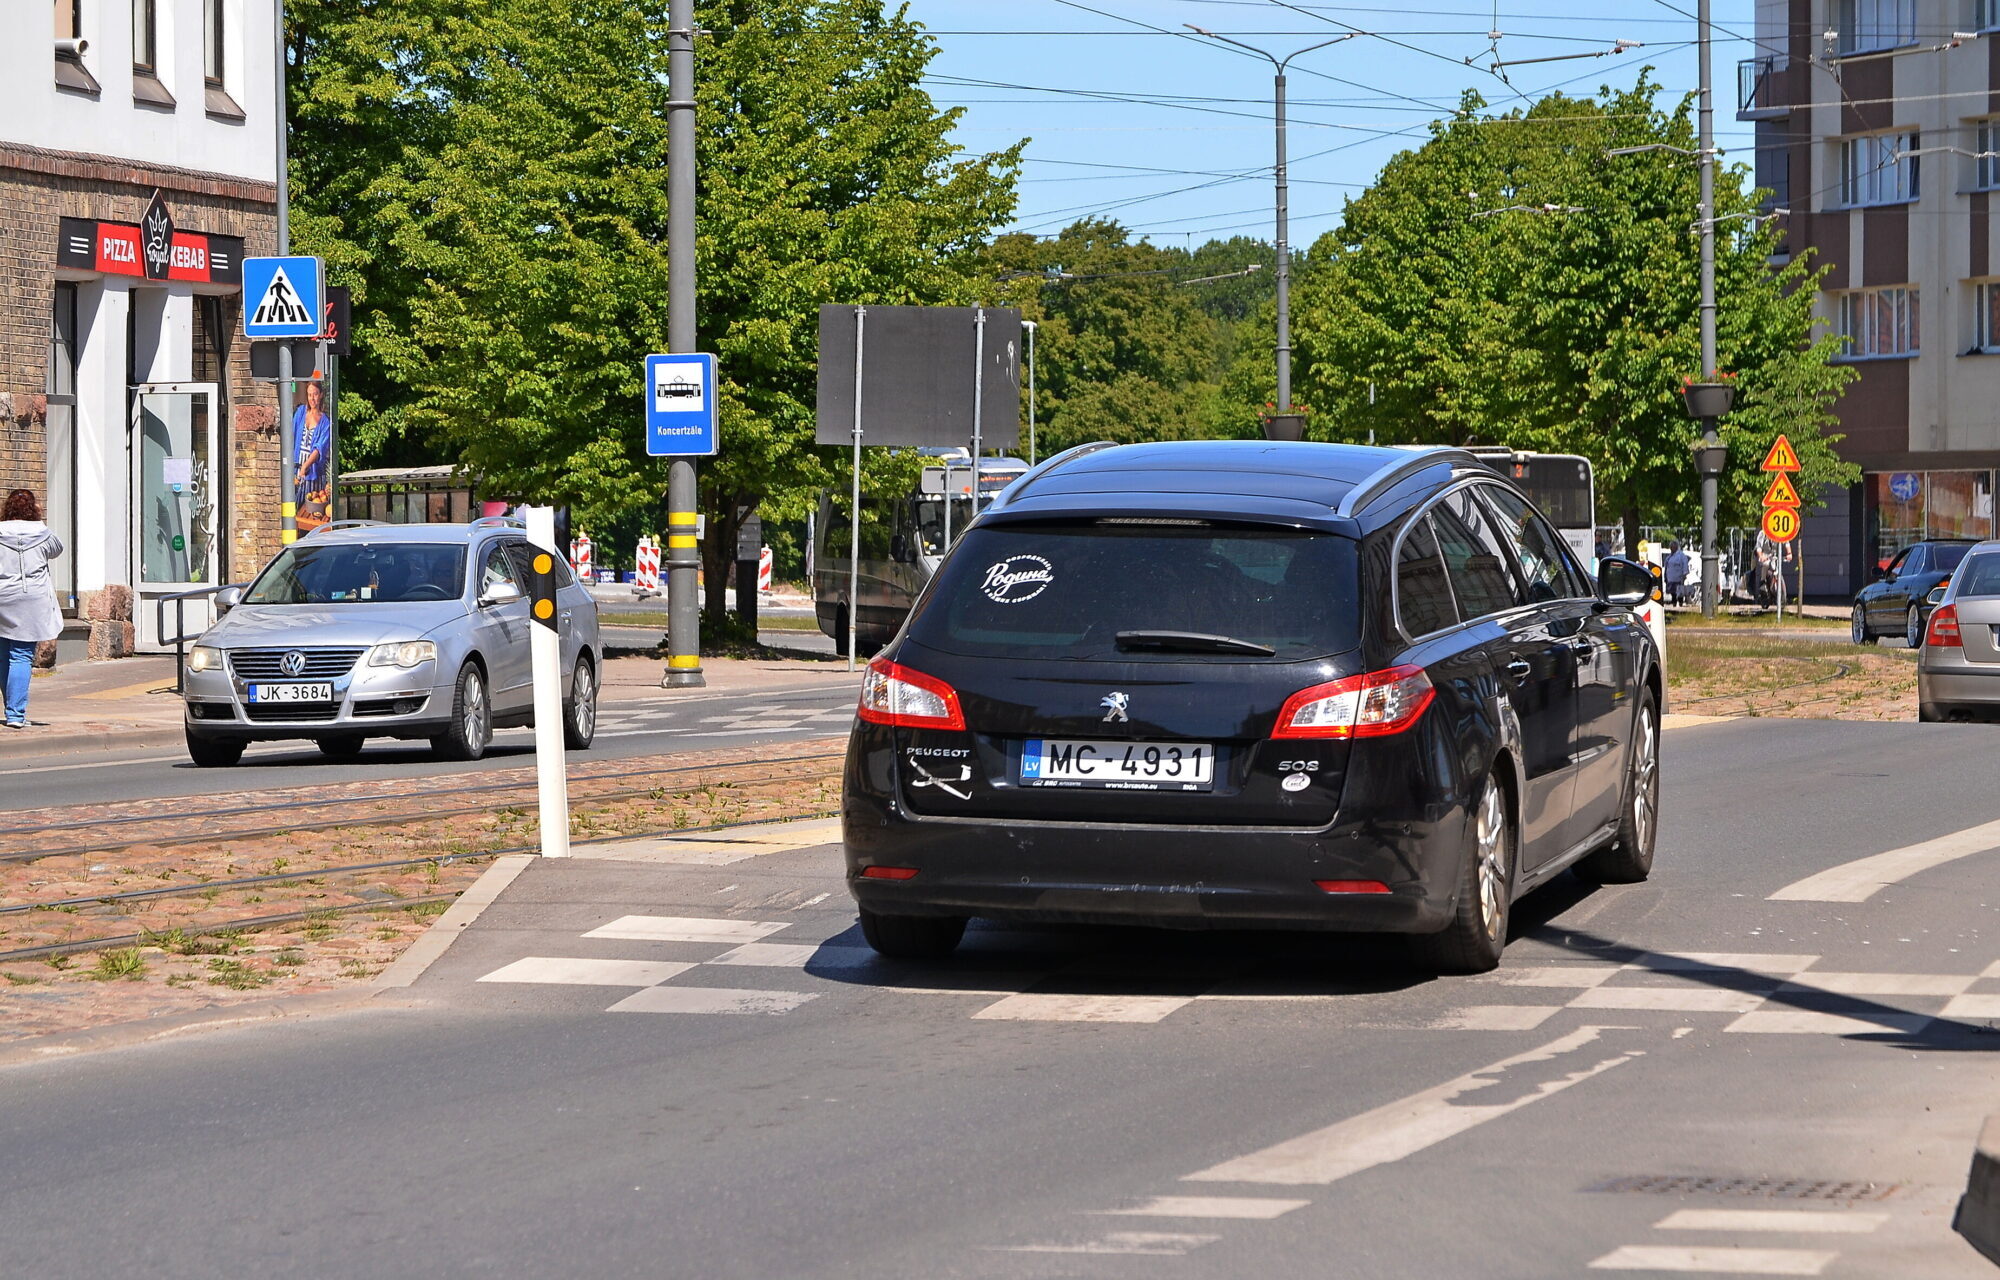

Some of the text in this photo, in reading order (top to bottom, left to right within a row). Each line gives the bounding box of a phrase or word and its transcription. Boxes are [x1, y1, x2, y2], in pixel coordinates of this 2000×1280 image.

[103, 237, 205, 269] PIZZA KEBAB
[147, 236, 170, 273] royal
[1772, 514, 1790, 532] 30
[980, 562, 1055, 597] Родина
[906, 747, 970, 758] PEUGEOT
[1025, 762, 1039, 771] LV
[1278, 760, 1319, 771] 508
